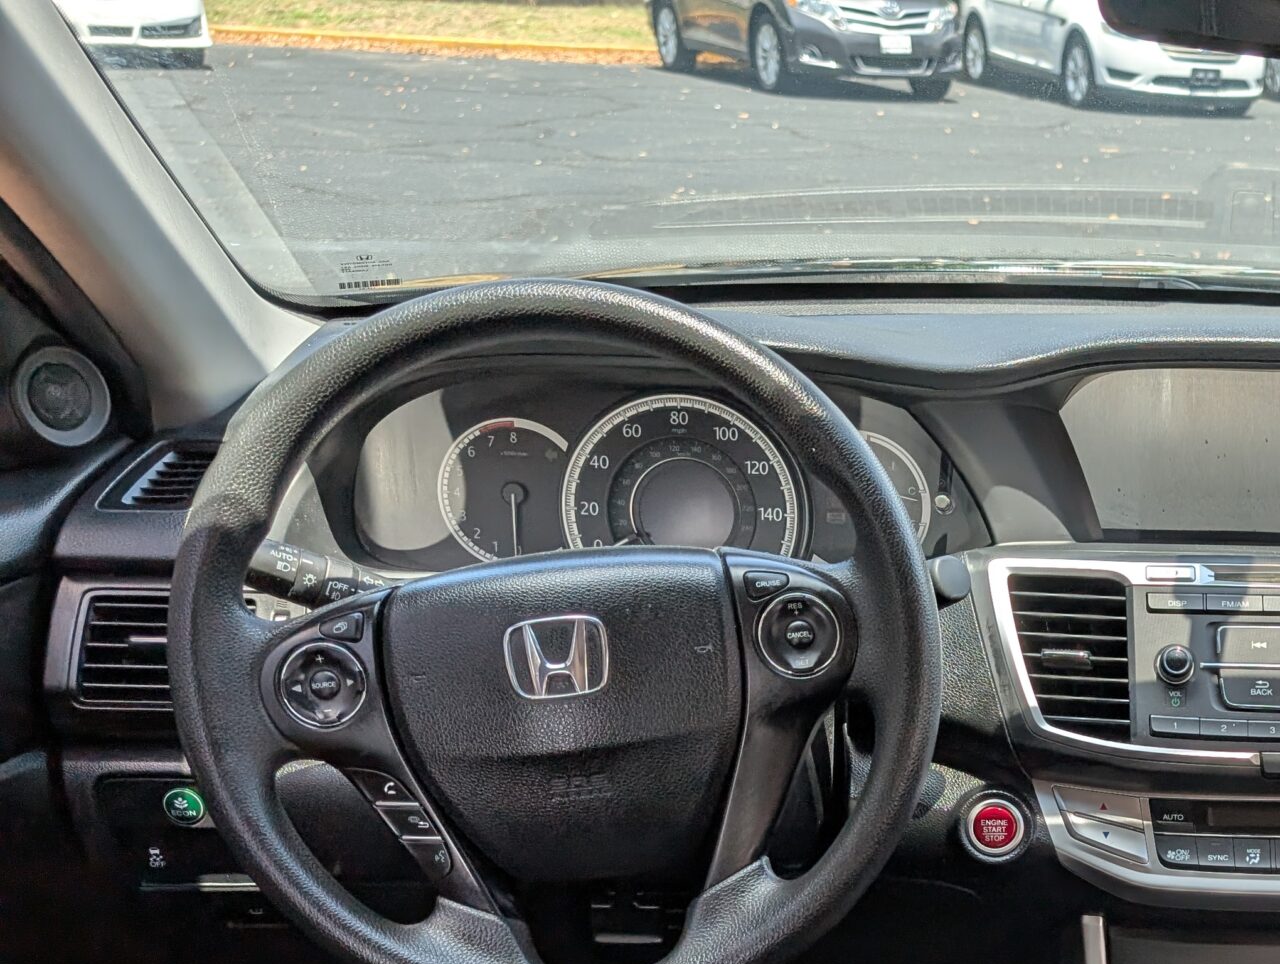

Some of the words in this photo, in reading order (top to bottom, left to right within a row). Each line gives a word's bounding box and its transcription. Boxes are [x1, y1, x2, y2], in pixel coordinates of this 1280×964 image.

[670, 411, 689, 425] 80
[622, 424, 642, 437] 60
[713, 426, 739, 441] 100
[488, 436, 495, 447] 7
[509, 432, 517, 444] 8
[467, 446, 476, 458] 6
[589, 455, 609, 469] 40
[745, 461, 769, 475] 120
[453, 487, 460, 497] 4
[908, 486, 916, 495] C
[580, 502, 599, 516] 20
[758, 507, 782, 521] 140
[460, 511, 467, 521] 3
[473, 527, 481, 539] 2
[492, 541, 498, 552] 1
[270, 550, 294, 561] AUTO
[331, 582, 349, 591] OFF
[755, 580, 781, 588] CRUISE
[787, 631, 811, 639] CANCEL
[311, 681, 336, 690] SOURCE
[1250, 688, 1273, 696] BACK
[1269, 726, 1276, 734] 3
[170, 809, 197, 817] ECON
